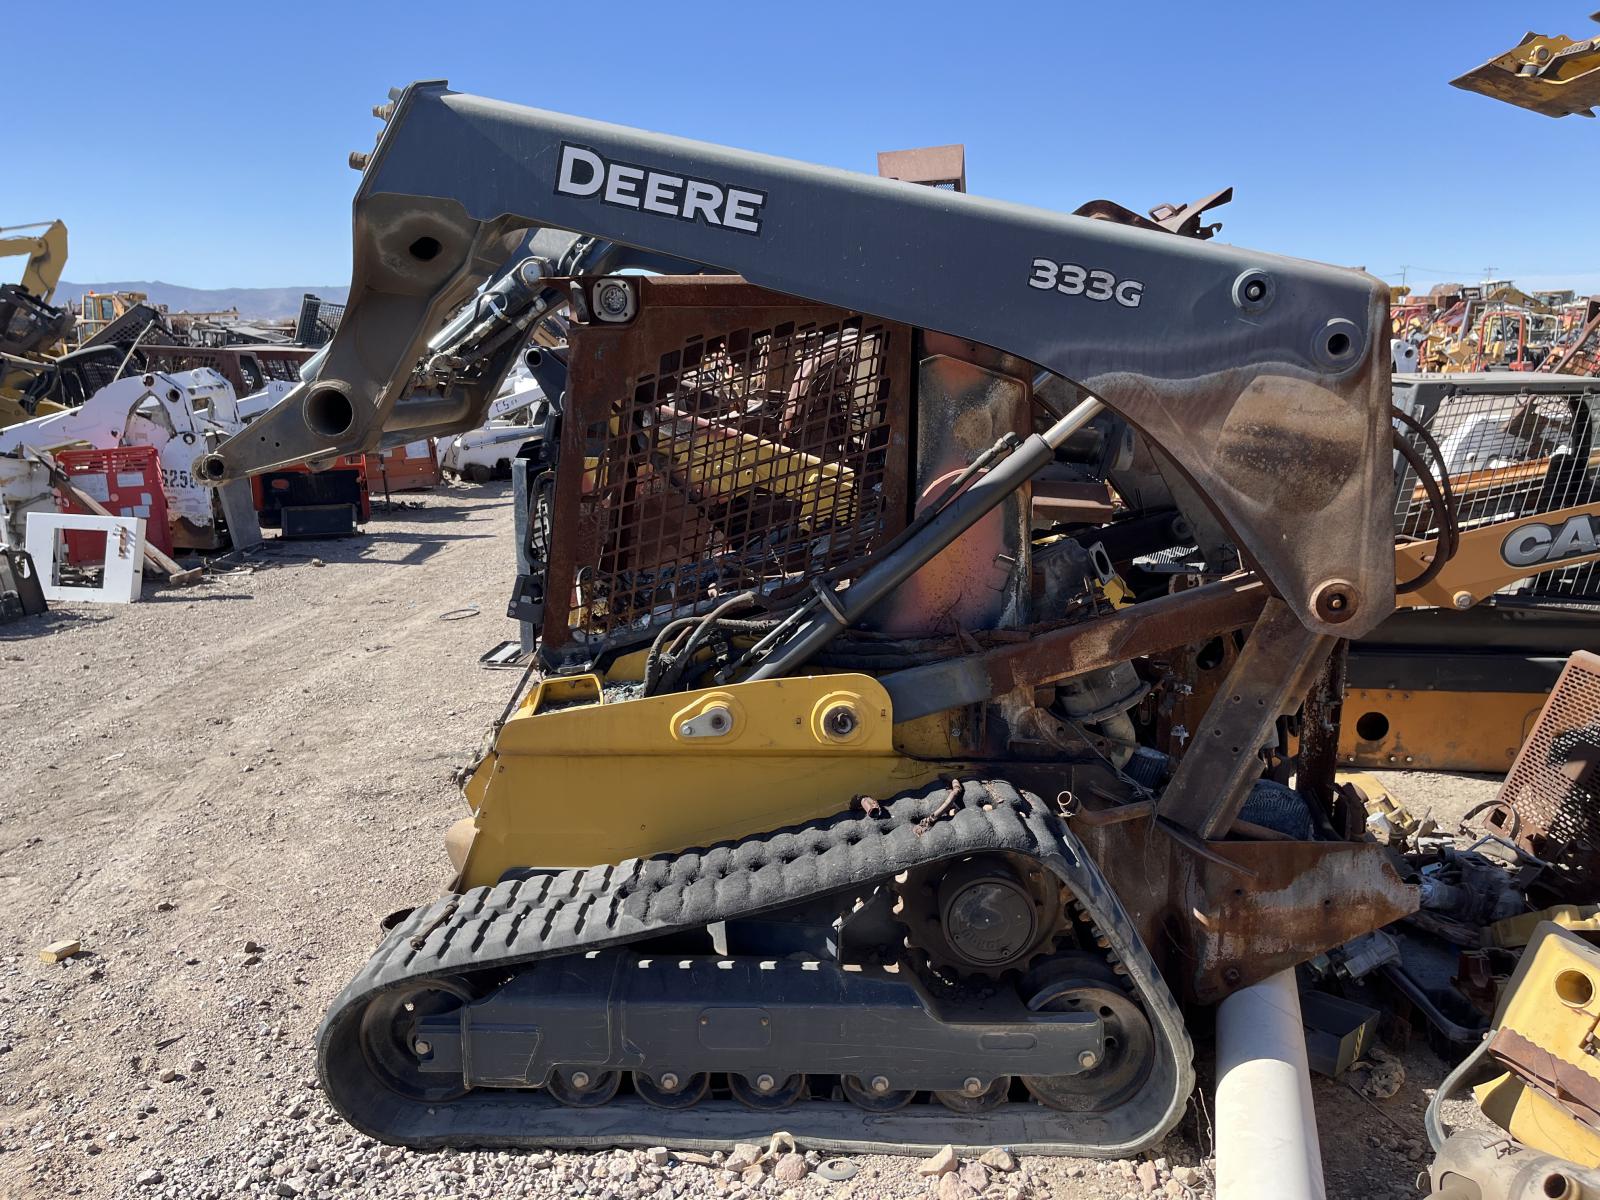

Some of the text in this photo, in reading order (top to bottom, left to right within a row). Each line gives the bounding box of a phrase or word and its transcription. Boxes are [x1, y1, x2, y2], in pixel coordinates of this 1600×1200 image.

[557, 145, 764, 233] DEERE
[1029, 258, 1143, 307] 333G
[1504, 514, 1600, 565] CA
